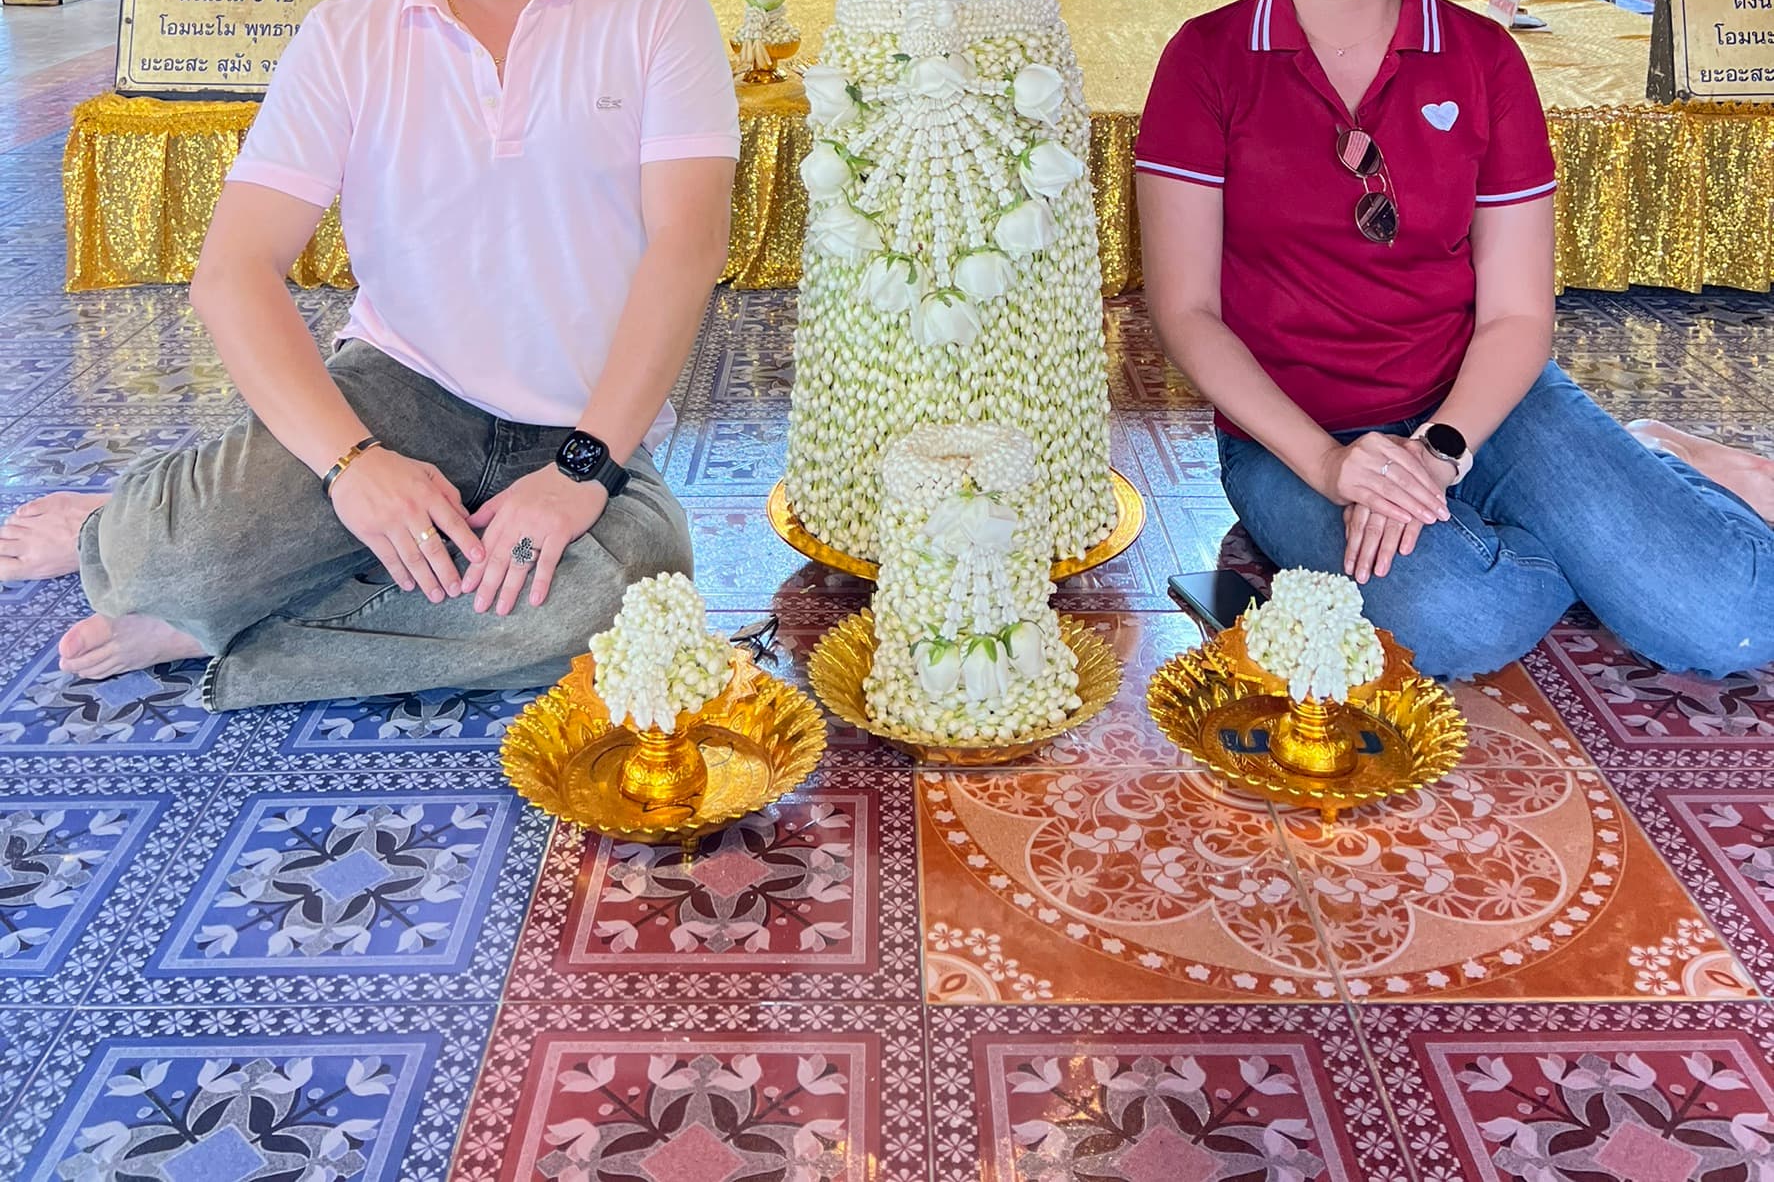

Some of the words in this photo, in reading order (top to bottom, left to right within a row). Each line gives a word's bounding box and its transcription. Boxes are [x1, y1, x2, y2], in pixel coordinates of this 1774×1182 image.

[160, 14, 236, 36] โอมนะโม
[141, 56, 208, 72] ยะอะสะ
[217, 52, 252, 79] สุมัง
